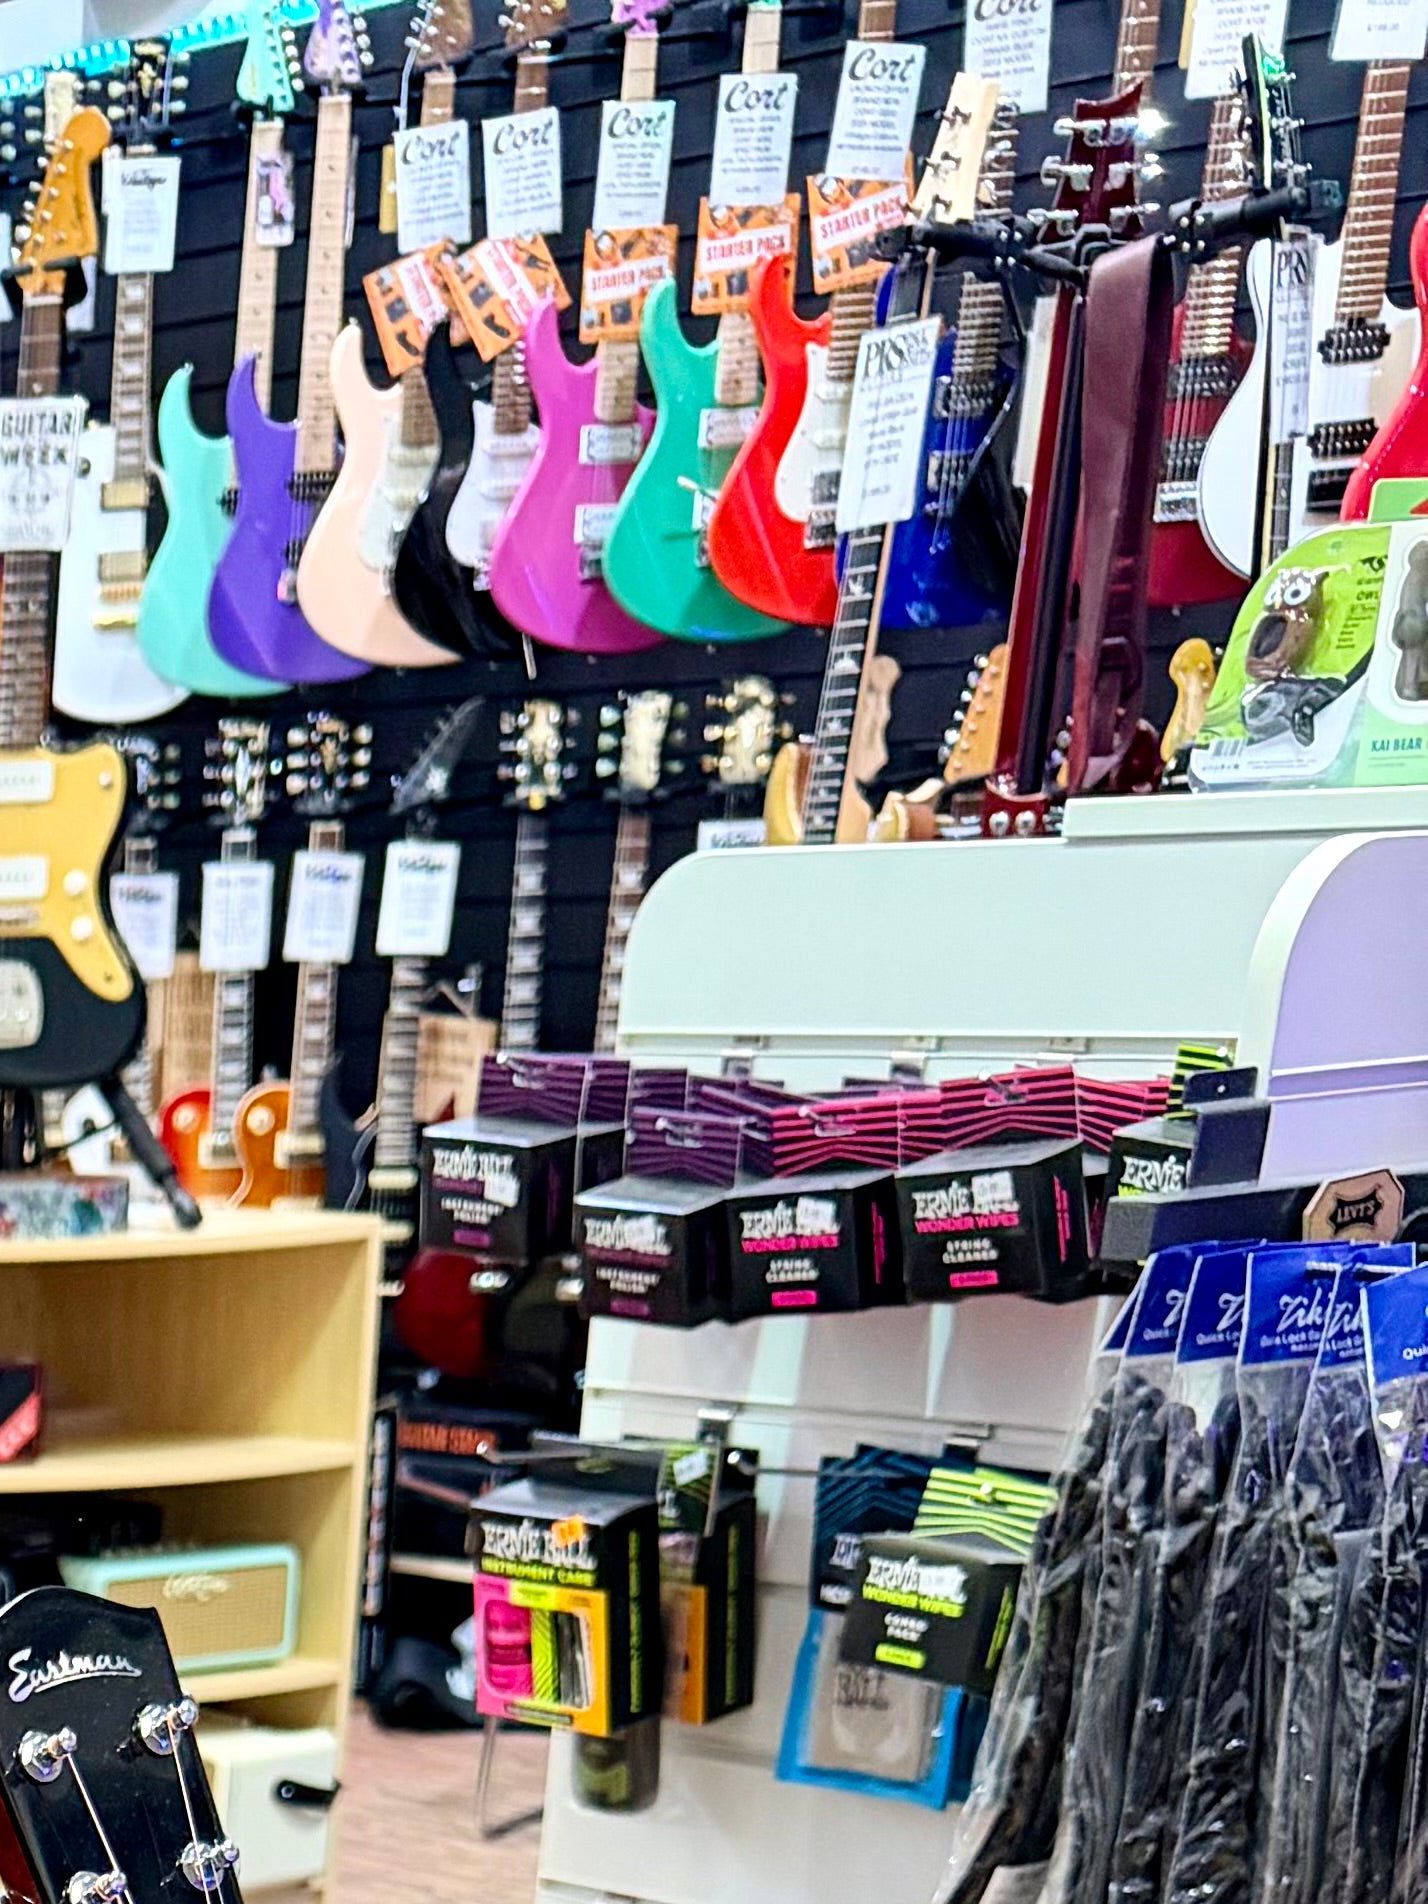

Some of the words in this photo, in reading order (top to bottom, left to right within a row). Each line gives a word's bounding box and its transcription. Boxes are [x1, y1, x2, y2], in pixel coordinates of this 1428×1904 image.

[849, 48, 913, 82] Cort
[724, 80, 788, 113] Cort
[493, 116, 554, 155] Cort
[608, 108, 666, 139] Cort
[1, 411, 74, 438] GUITAR
[1394, 738, 1422, 751] BEAR
[1122, 1155, 1186, 1194] ERNIE
[912, 1181, 971, 1219] ERNIE
[1402, 1345, 1428, 1361] Qui
[481, 1518, 542, 1562] ERNIE
[7, 1647, 142, 1702] Eastman
